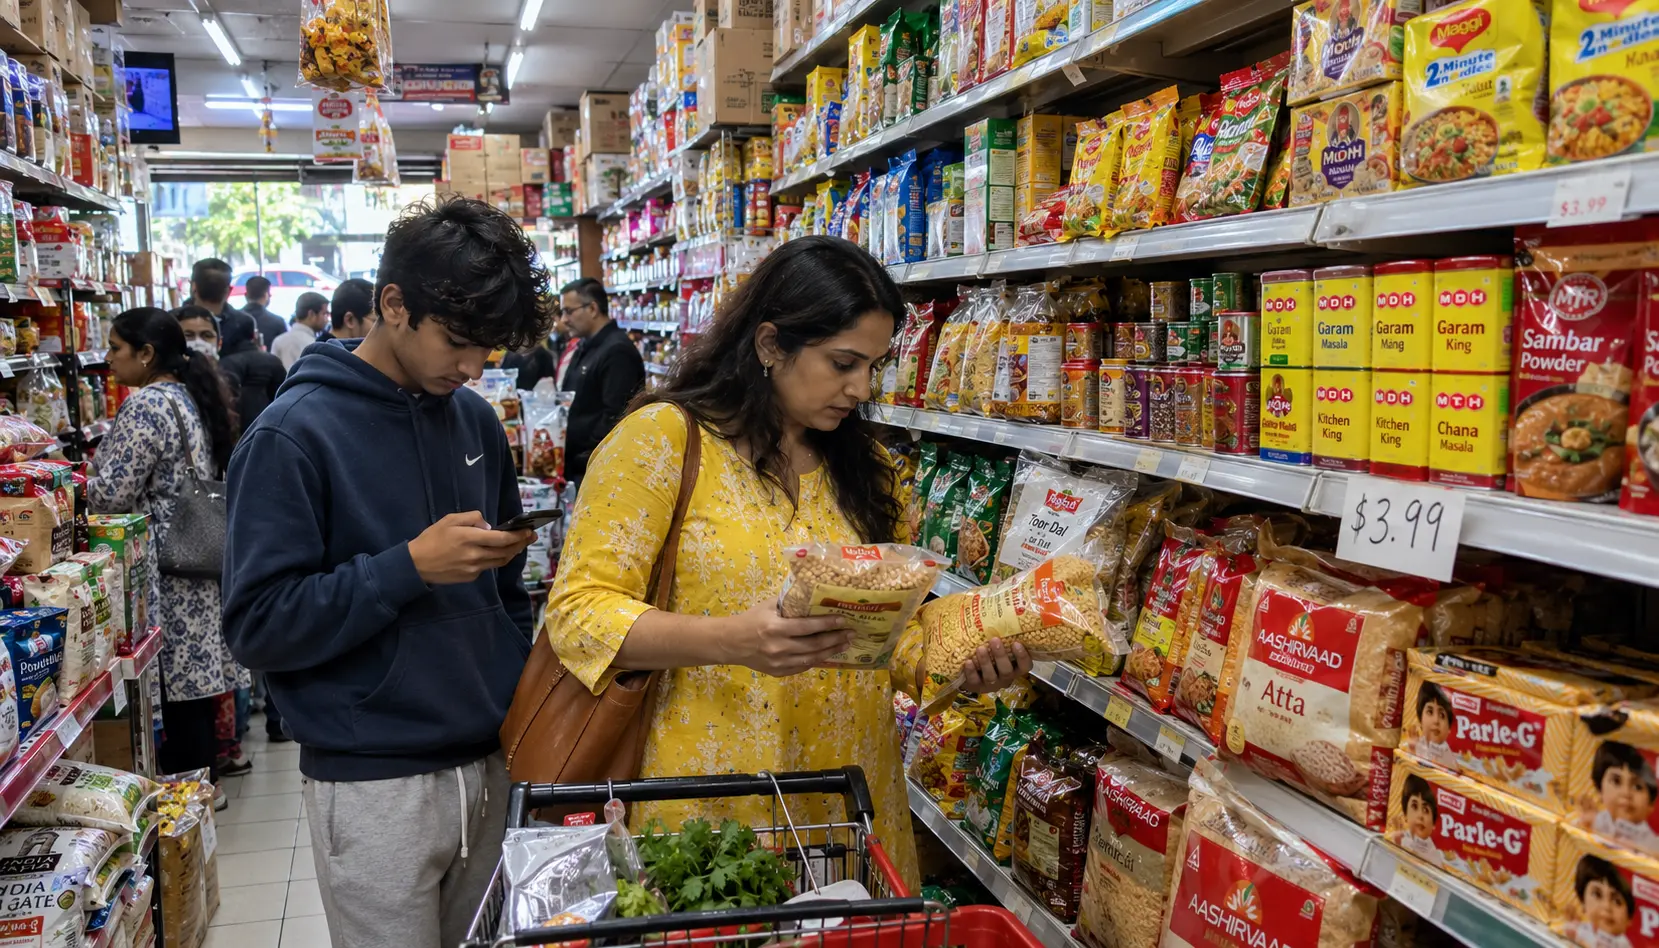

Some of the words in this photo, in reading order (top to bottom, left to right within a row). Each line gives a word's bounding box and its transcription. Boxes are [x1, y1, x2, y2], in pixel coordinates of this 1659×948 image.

[1437, 16, 1483, 41] Maggi
[1561, 196, 1607, 218] $3.99
[1265, 299, 1295, 311] MDH
[1318, 296, 1354, 310] MDH
[1377, 294, 1414, 307] MDH
[1440, 291, 1485, 305] MDH
[1318, 322, 1353, 335] Garam
[1377, 321, 1414, 334] Garam
[1438, 320, 1485, 335] Garam
[1322, 339, 1348, 349] Masala
[1446, 338, 1472, 354] King
[1522, 329, 1604, 352] Sambar
[1521, 352, 1585, 372] Powder
[1375, 391, 1412, 404] MDH
[1318, 412, 1350, 426] Kitchen
[1376, 417, 1409, 431] Kitchen
[1323, 428, 1342, 442] King
[1438, 421, 1478, 437] Chana
[1381, 433, 1401, 448] King
[1440, 439, 1473, 452] Masala
[1049, 521, 1069, 537] Dal
[1351, 493, 1444, 552] $3.99
[1257, 629, 1343, 669] AASHIRVAAD
[1261, 679, 1305, 717] Atta
[1456, 715, 1537, 748] Parle-G
[1440, 813, 1523, 855] Parle-G
